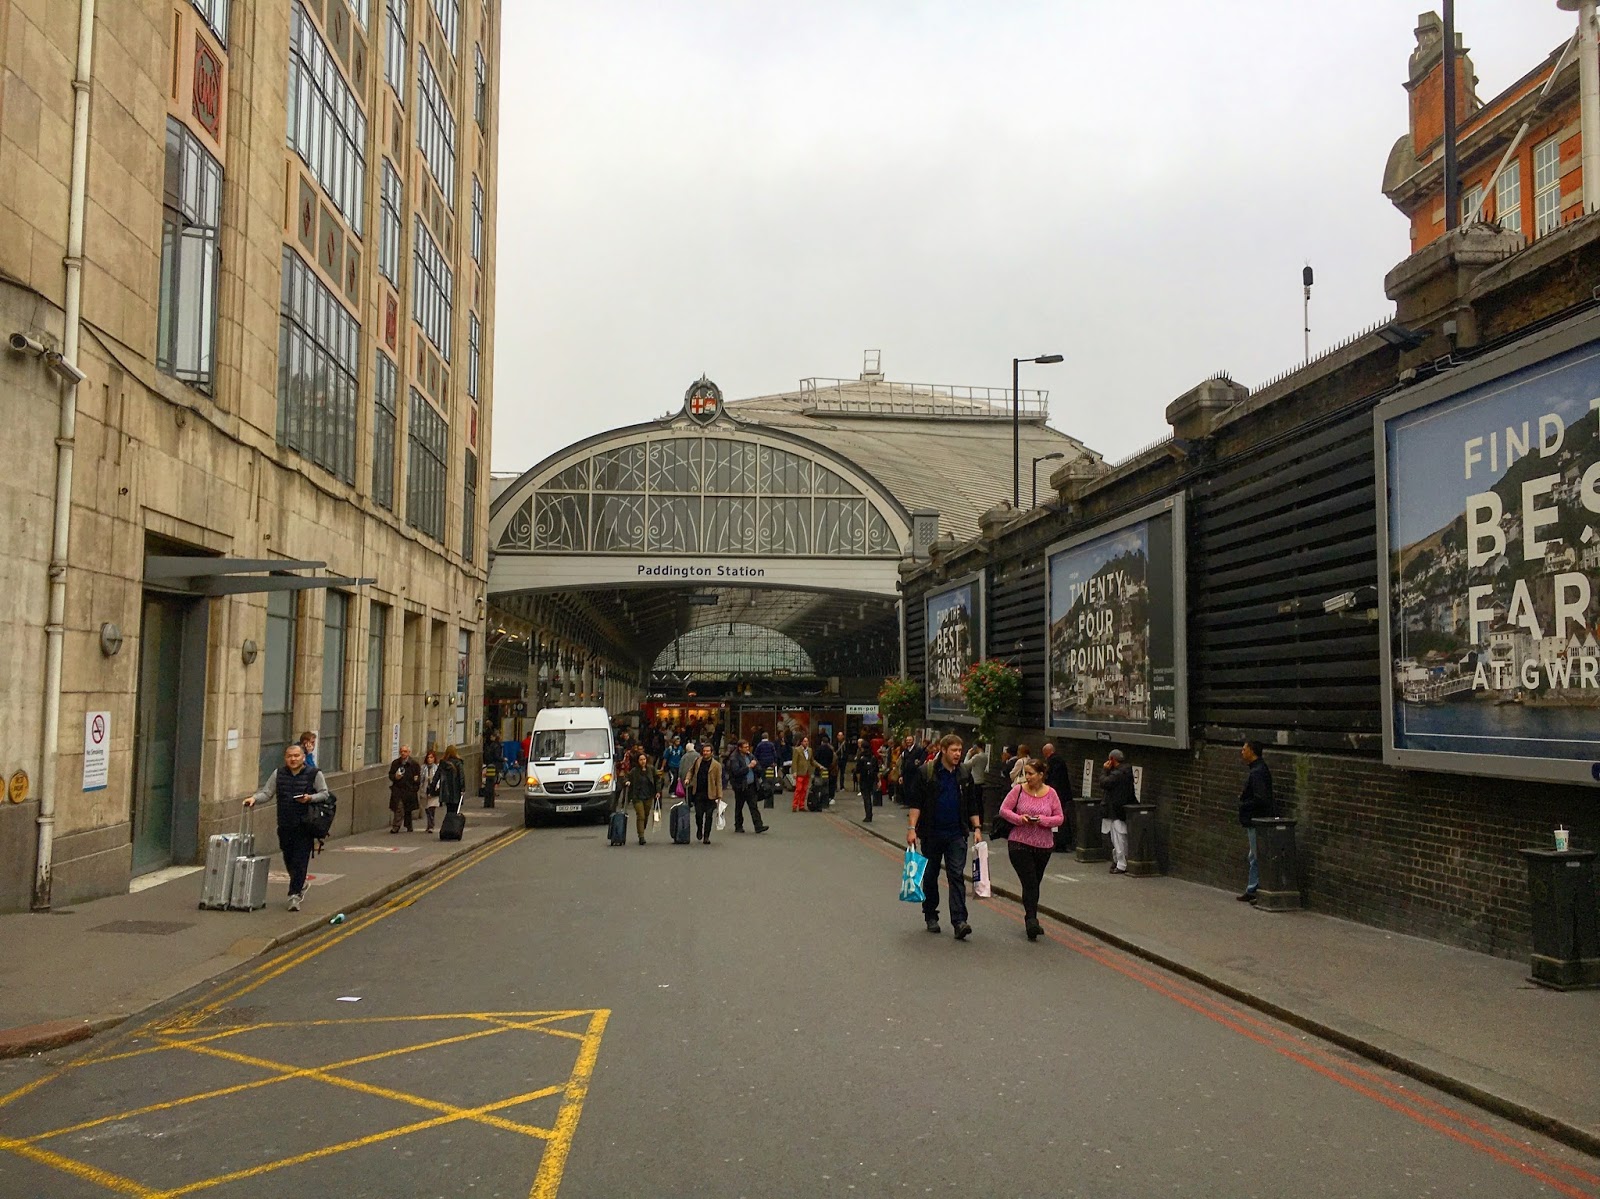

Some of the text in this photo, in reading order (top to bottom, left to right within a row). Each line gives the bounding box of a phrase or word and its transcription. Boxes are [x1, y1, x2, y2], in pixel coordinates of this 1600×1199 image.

[1465, 413, 1565, 479] FIND
[637, 565, 765, 577] Paddington Station
[1069, 569, 1124, 608] TWENTY
[1078, 608, 1114, 638] FOUR
[937, 626, 961, 654] BEST
[937, 656, 961, 679] FARES
[1070, 643, 1124, 673] POUNDS
[1471, 660, 1506, 690] AT
